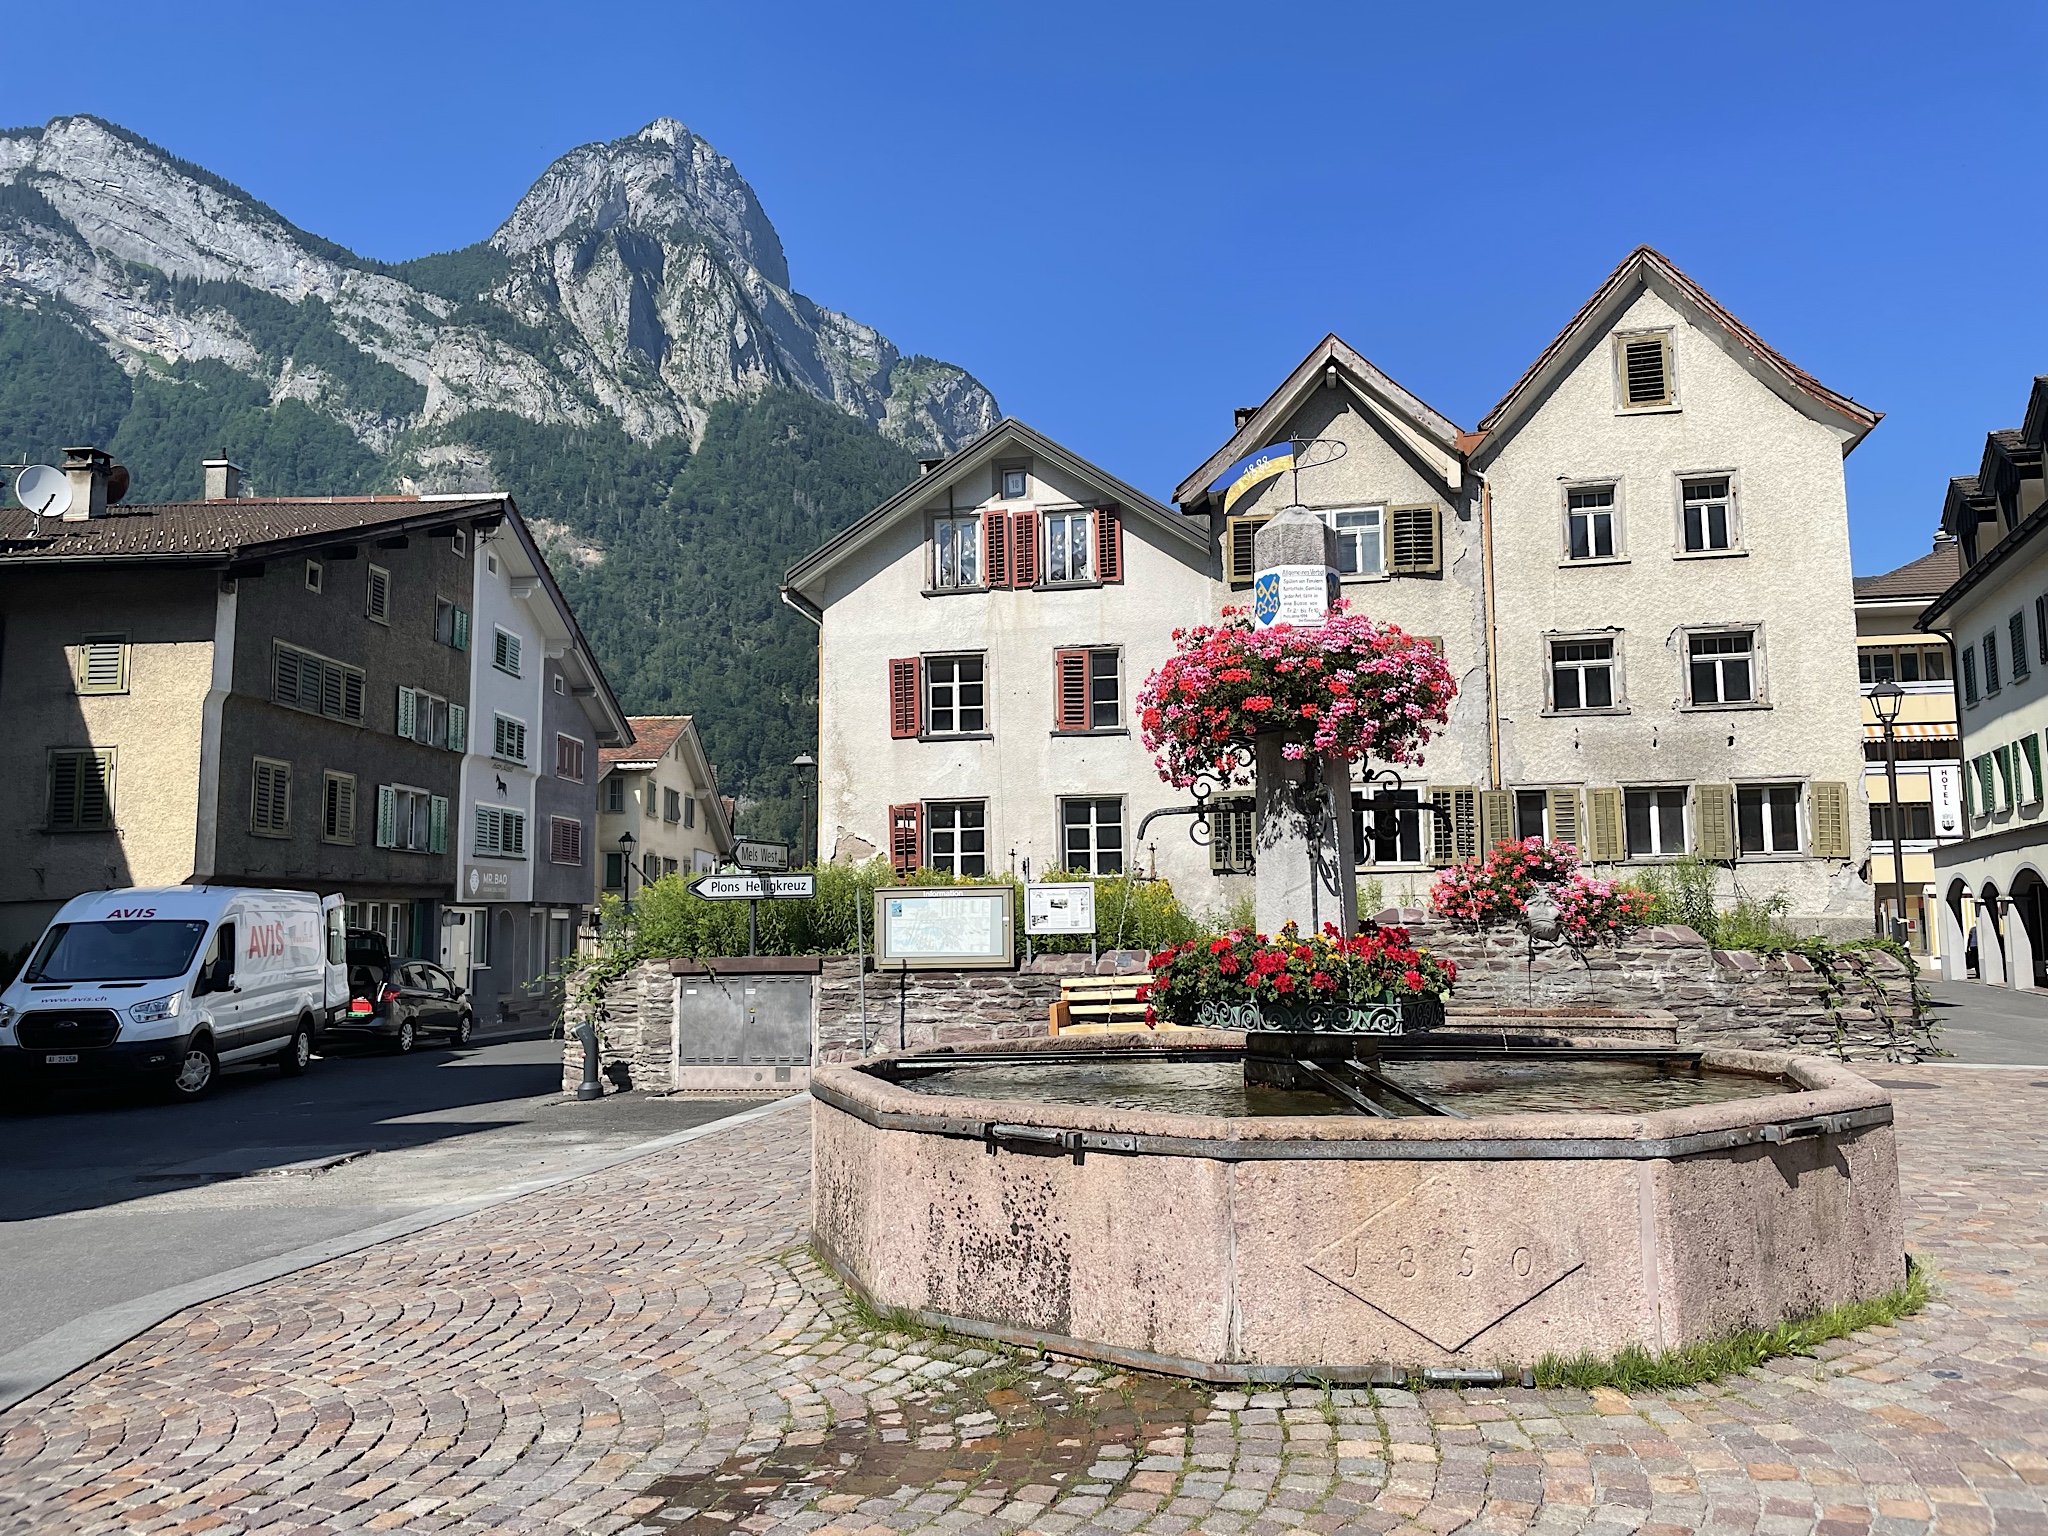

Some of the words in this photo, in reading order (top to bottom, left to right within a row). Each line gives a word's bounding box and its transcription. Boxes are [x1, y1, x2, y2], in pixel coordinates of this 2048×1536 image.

[1243, 455, 1270, 479] 1888
[1011, 479, 1020, 489] 18
[1941, 769, 1949, 805] HOTEL
[741, 846, 758, 862] Mels
[760, 847, 778, 863] West
[494, 873, 508, 885] BAO
[711, 881, 740, 893] Plons
[746, 880, 807, 894] Heiligkreuz
[922, 890, 964, 898] Information
[106, 908, 157, 919] AVIS
[248, 922, 285, 959] AVIS
